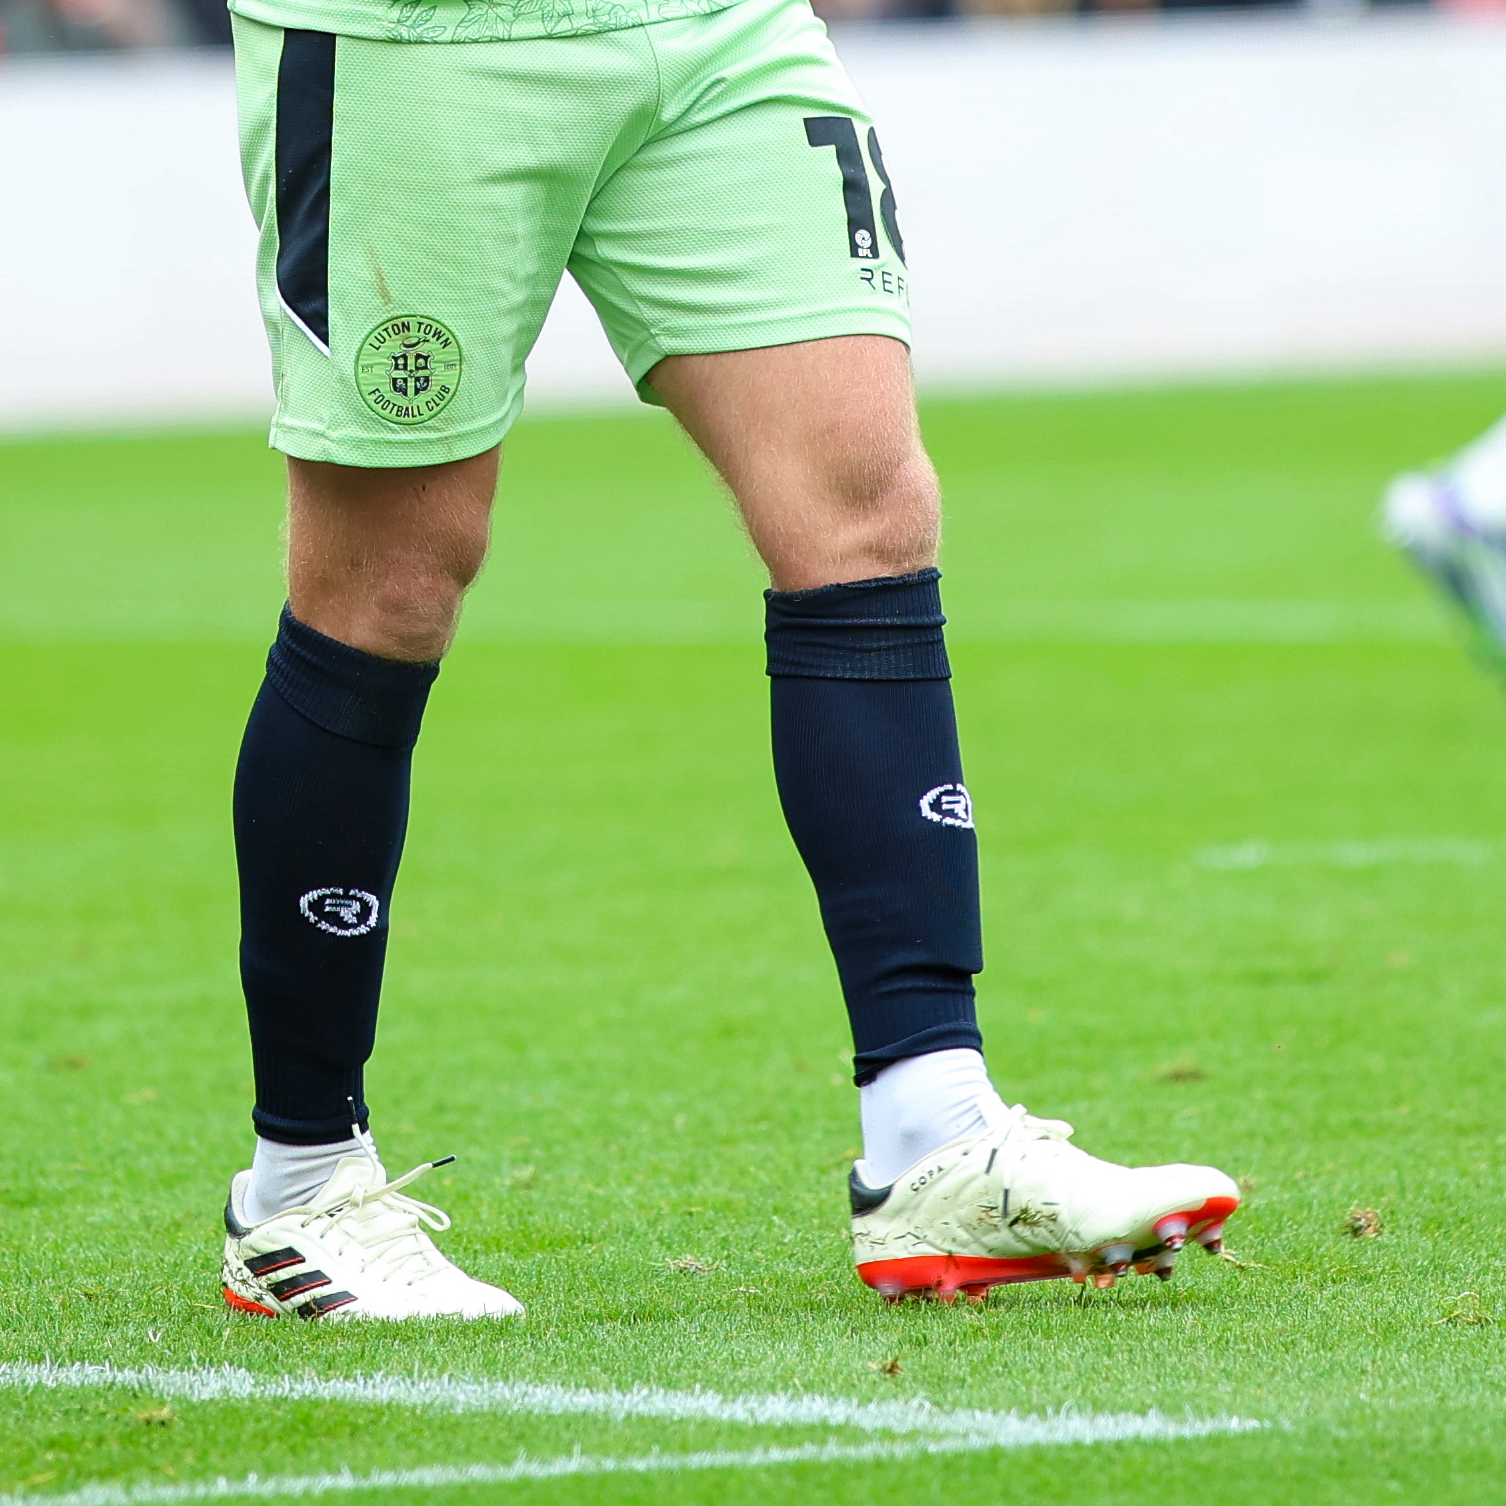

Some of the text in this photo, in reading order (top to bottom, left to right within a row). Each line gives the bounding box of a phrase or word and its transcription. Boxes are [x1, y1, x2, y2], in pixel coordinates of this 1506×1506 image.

[368, 321, 452, 351] LUTON TOWN
[368, 384, 451, 419] FOOTBALL CLUB
[910, 1165, 945, 1192] COPA
